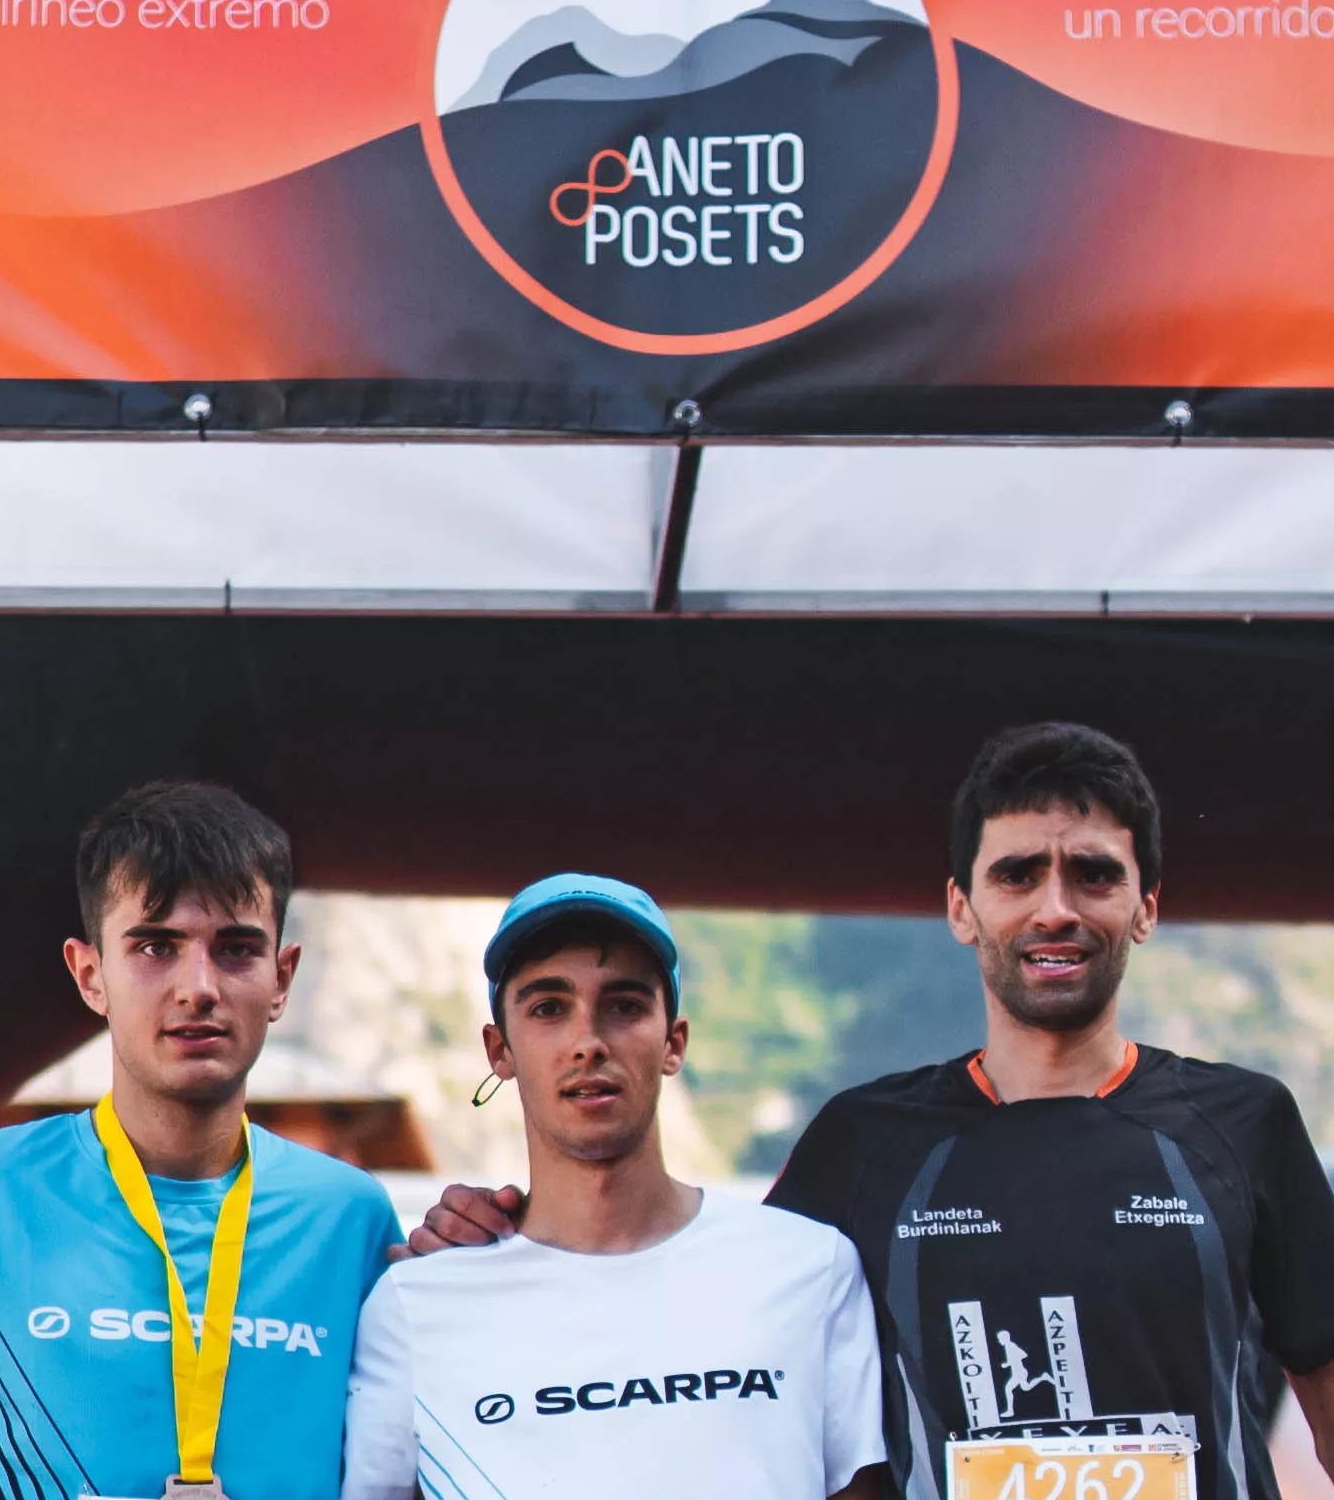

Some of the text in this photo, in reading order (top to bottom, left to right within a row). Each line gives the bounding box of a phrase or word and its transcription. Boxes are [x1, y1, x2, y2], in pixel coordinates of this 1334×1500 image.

[1064, 5, 1121, 40] un
[627, 133, 804, 197] ANETO
[585, 202, 804, 267] POSETS
[898, 1220, 1002, 1239] Burdinlanak
[913, 1207, 983, 1223] Landeta
[1115, 1209, 1204, 1227] Etxegintza
[535, 1369, 779, 1415] SCARPA
